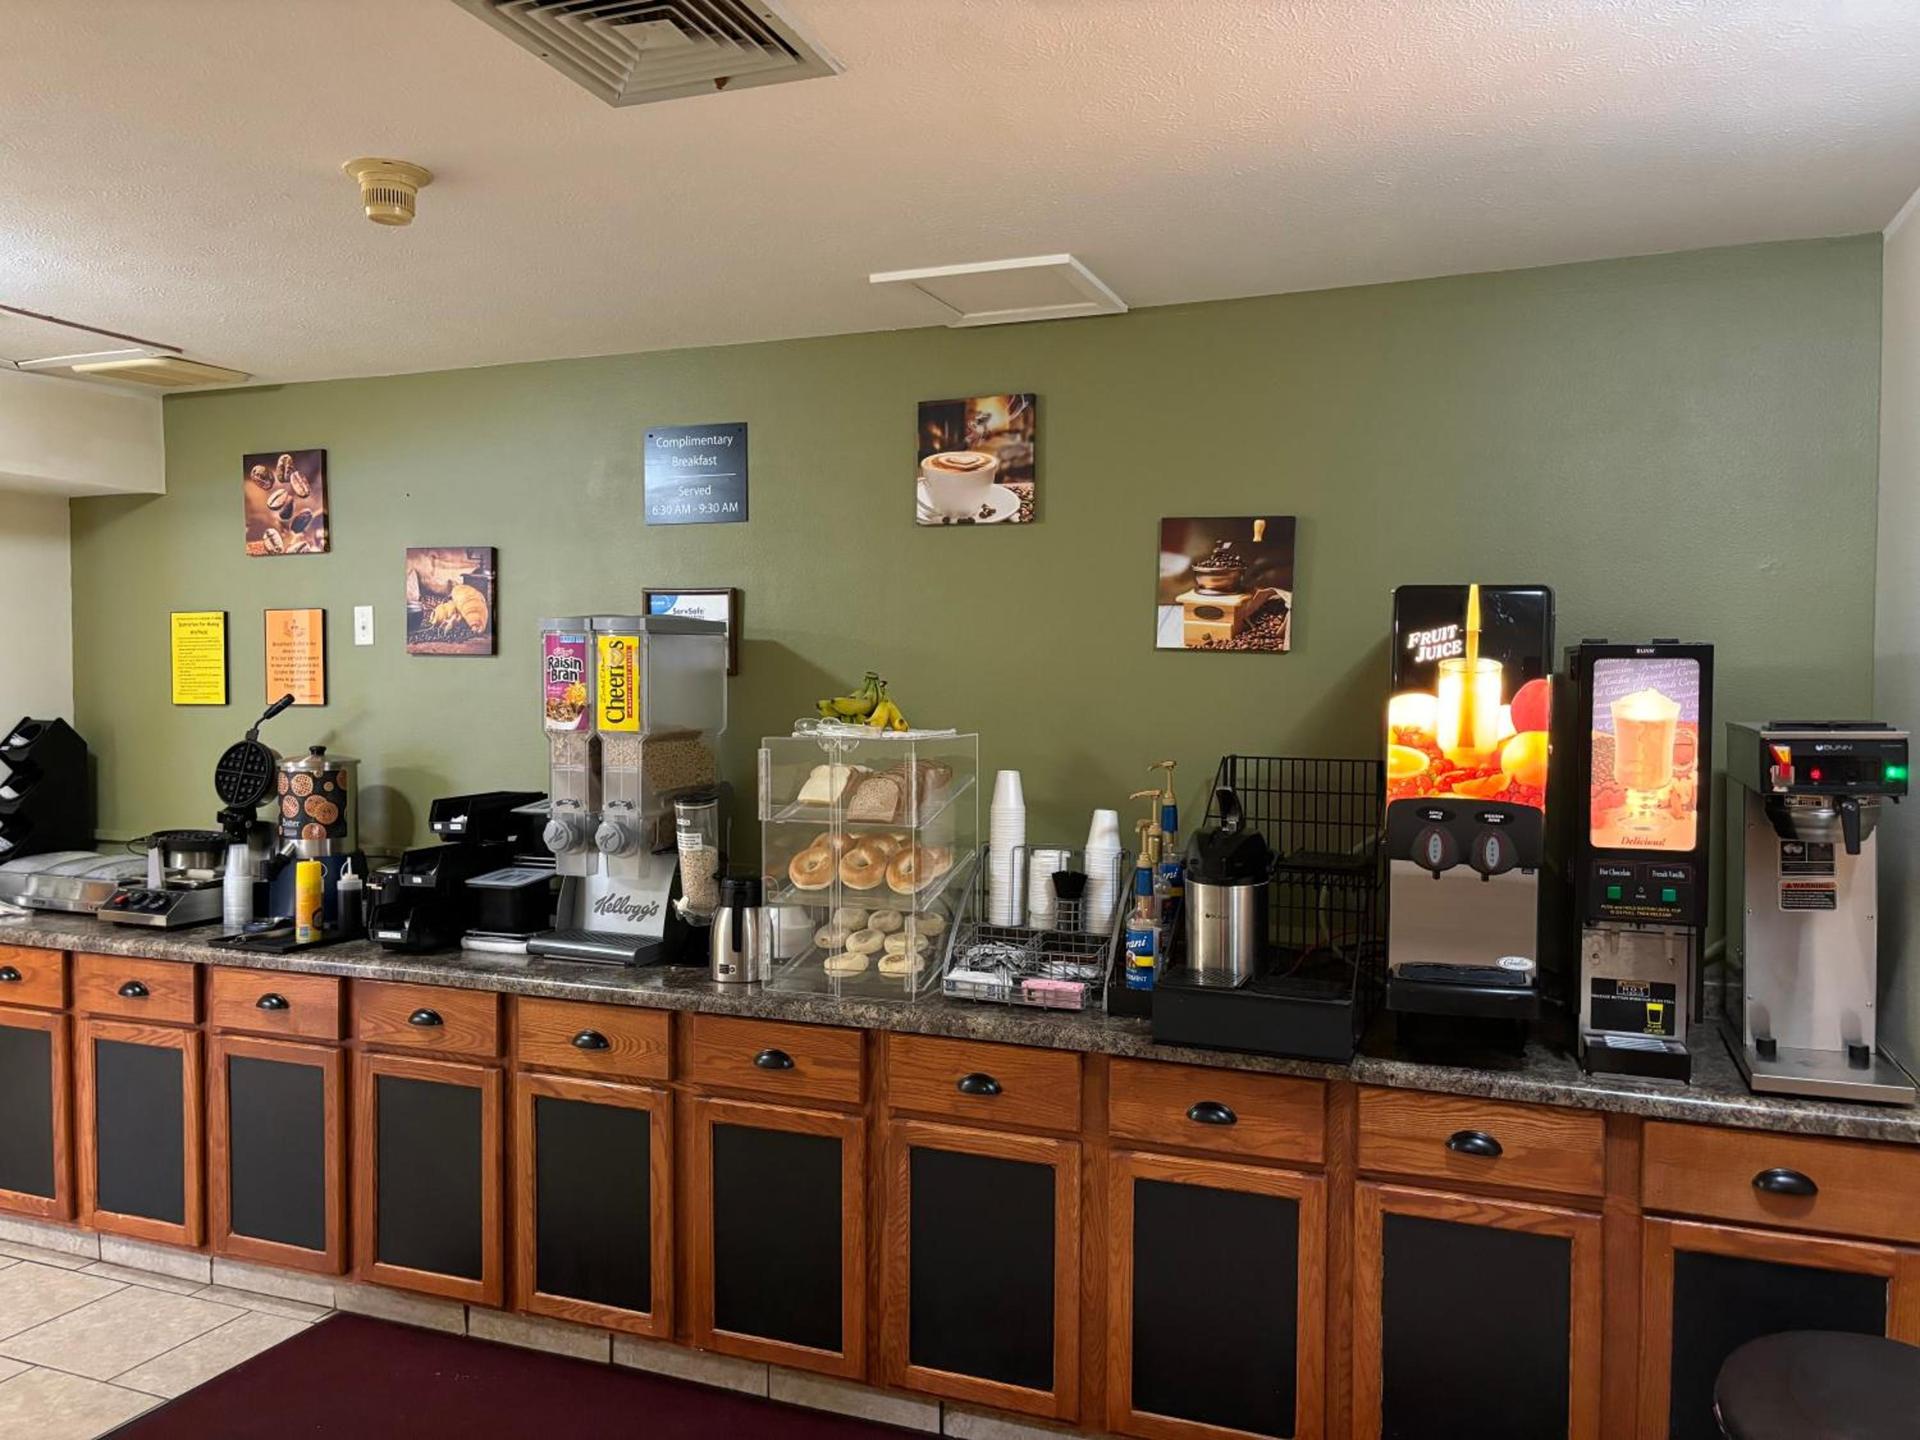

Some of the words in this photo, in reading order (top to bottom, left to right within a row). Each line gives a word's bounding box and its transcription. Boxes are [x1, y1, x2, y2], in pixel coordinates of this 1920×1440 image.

[656, 435, 734, 449] Complimentary
[671, 455, 718, 467] Breakfast
[679, 484, 712, 496] Served
[652, 503, 673, 516] 6:30
[674, 503, 692, 514] AM
[699, 502, 720, 514] 9:30
[721, 501, 739, 513] AM
[1407, 624, 1459, 650] FRUIT
[1415, 639, 1463, 663] JUICE
[547, 656, 582, 672] Raisin
[551, 669, 578, 681] Bran
[1620, 836, 1667, 848] Delicious!
[593, 892, 660, 922] Kellogg's
